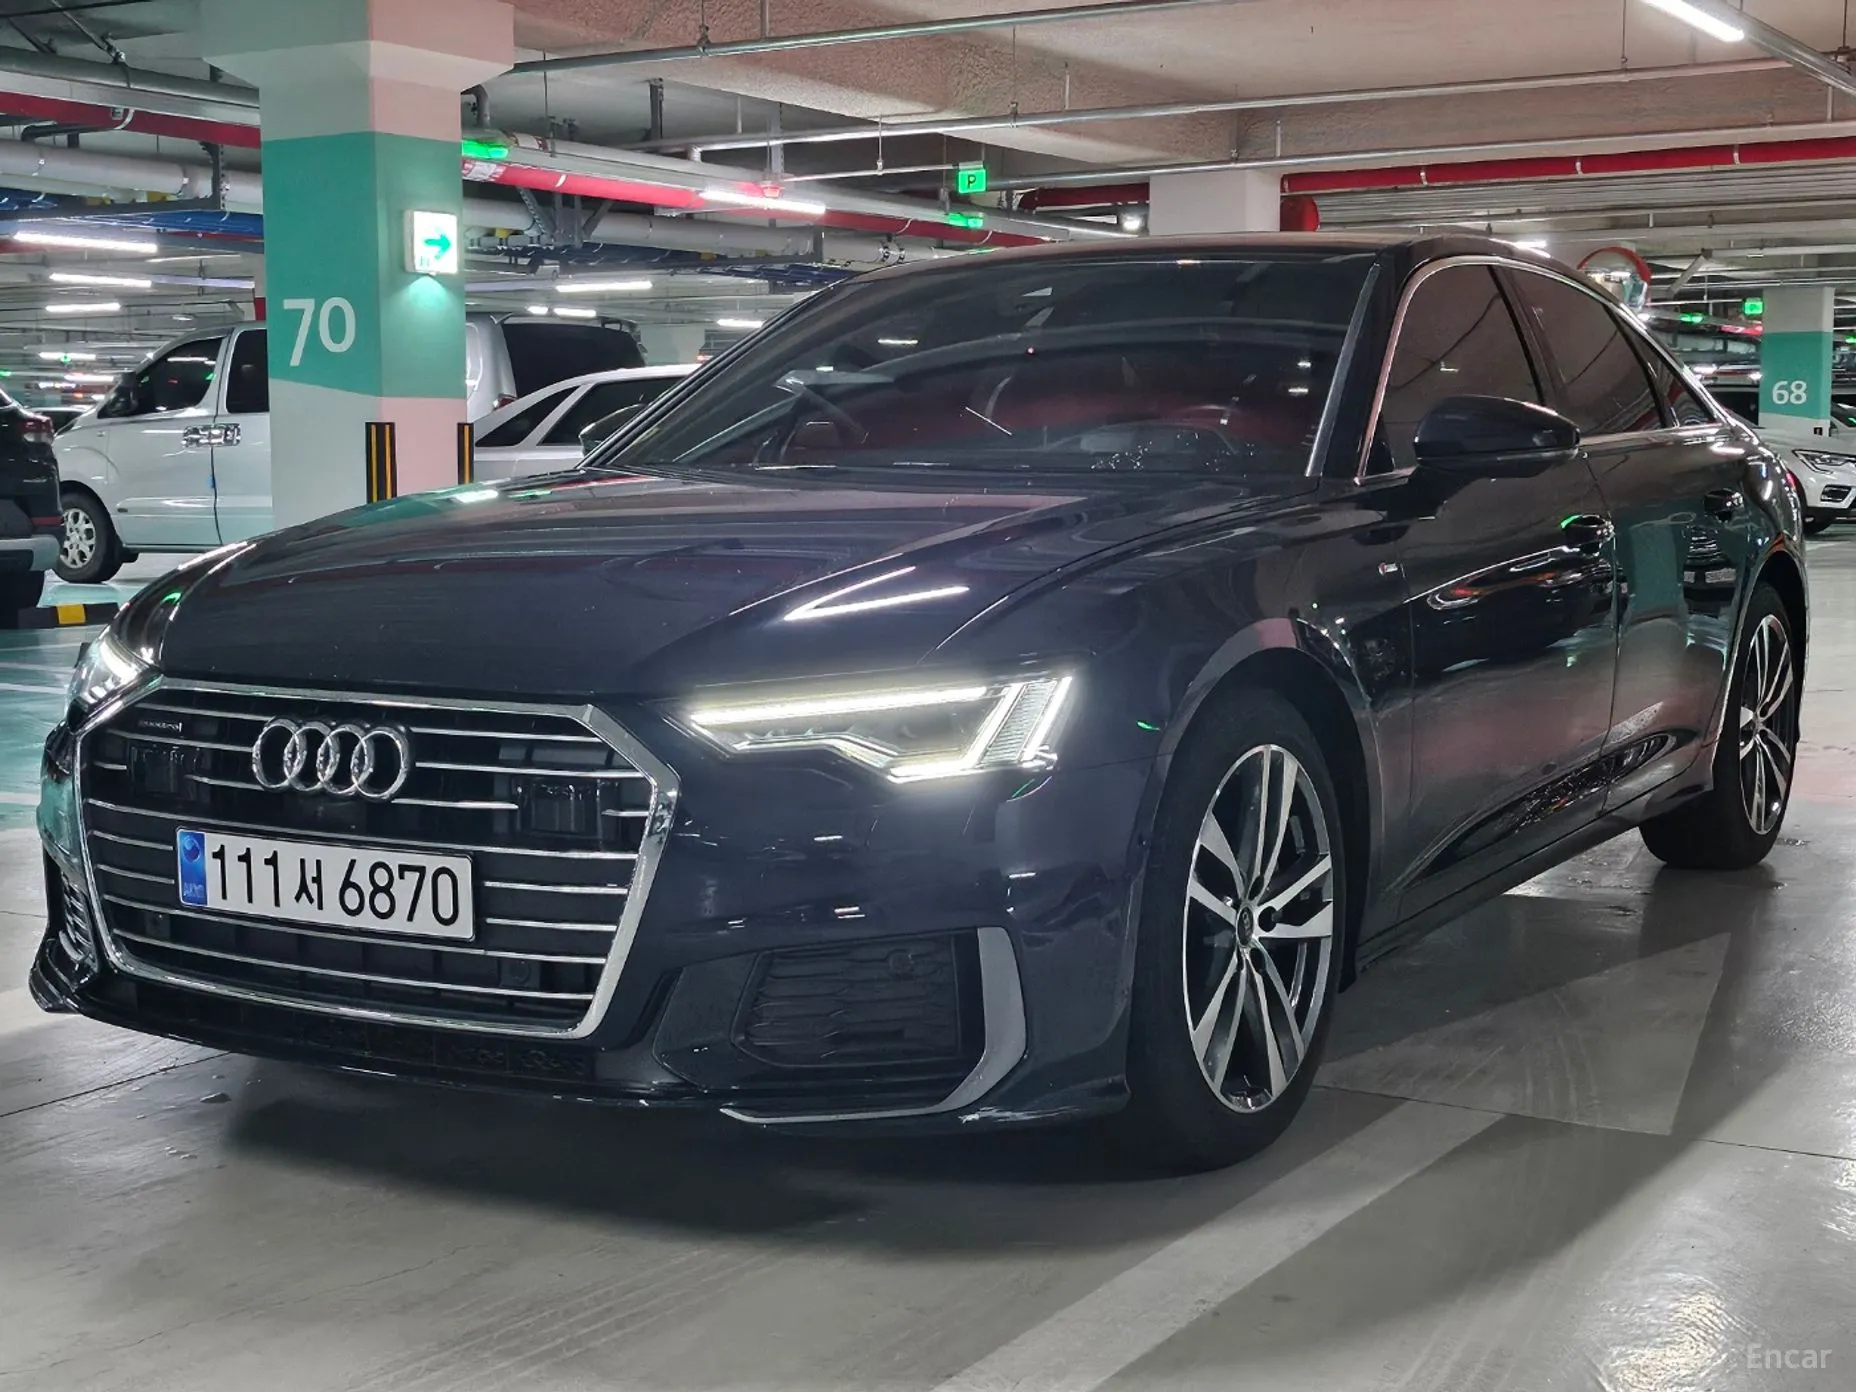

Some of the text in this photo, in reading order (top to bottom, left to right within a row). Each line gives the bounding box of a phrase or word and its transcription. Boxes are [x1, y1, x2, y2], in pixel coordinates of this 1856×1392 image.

[967, 174, 977, 189] P
[283, 296, 356, 367] 70
[1772, 380, 1807, 405] 68
